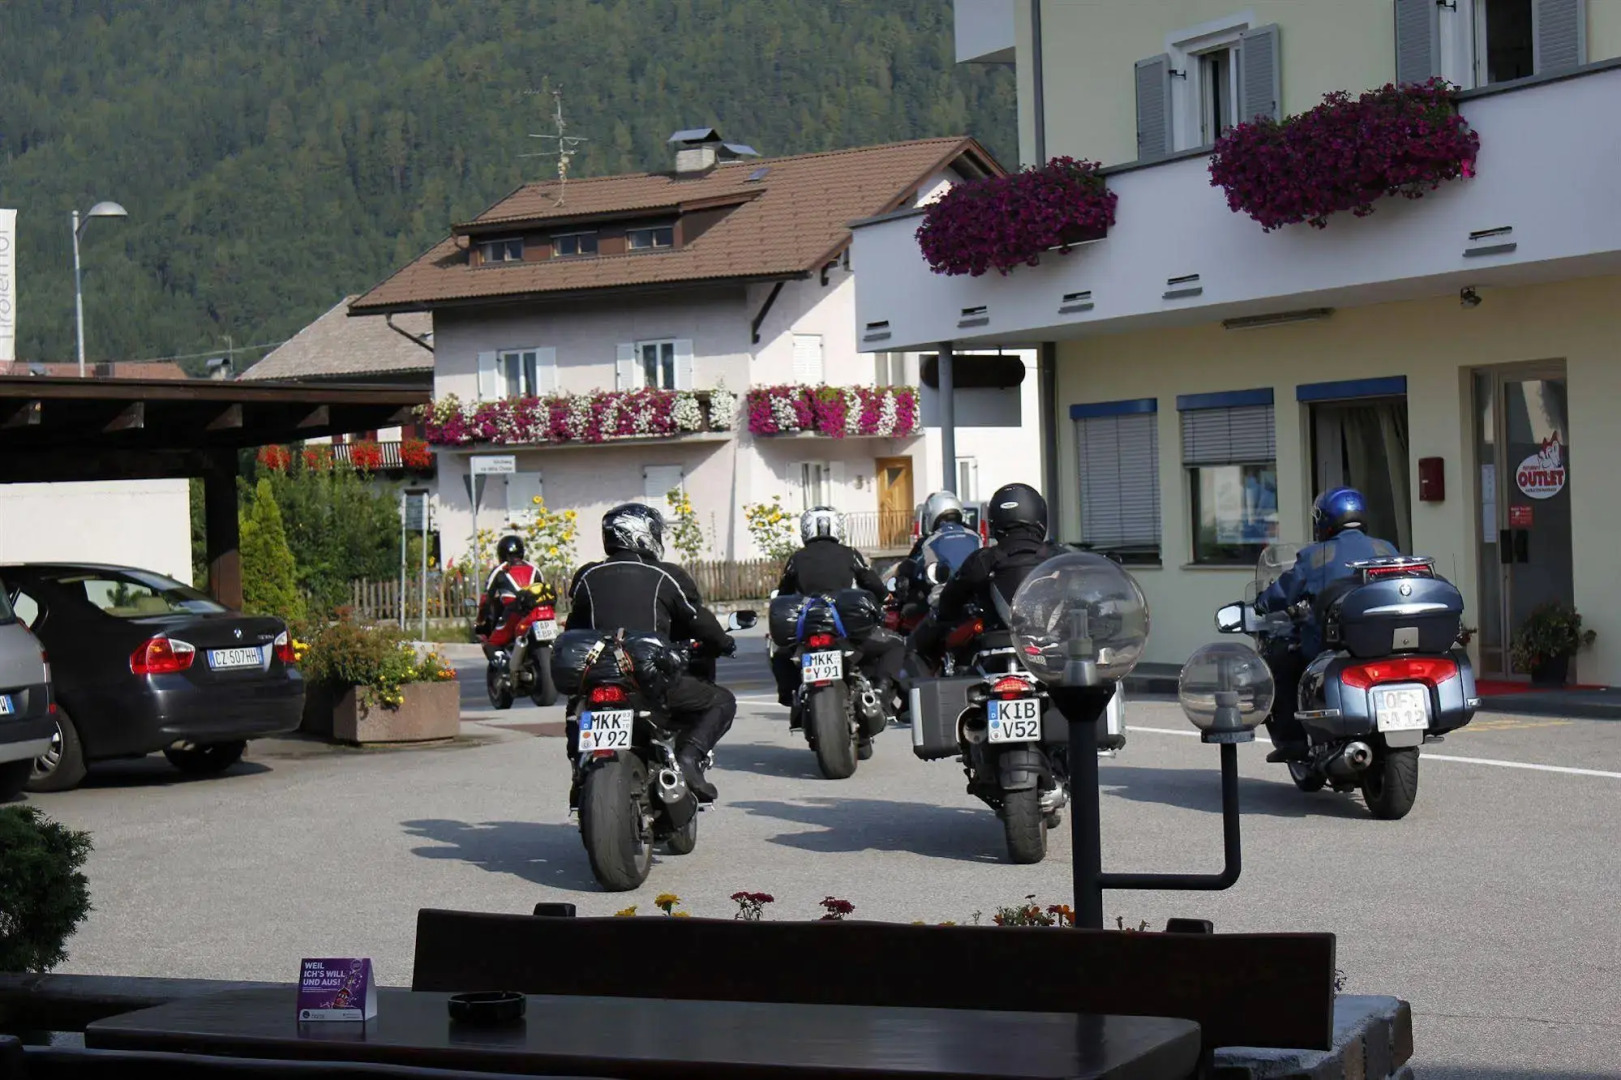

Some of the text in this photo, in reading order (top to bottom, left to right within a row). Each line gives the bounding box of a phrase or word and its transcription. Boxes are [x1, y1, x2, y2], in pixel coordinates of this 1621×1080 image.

[1517, 470, 1564, 487] OUTLET
[215, 649, 258, 665] CZ 507HH
[811, 653, 834, 666] MKK
[824, 665, 839, 678] 91
[999, 702, 1036, 720] KIB
[591, 713, 622, 730] MKK
[1002, 720, 1038, 739] V52
[607, 730, 628, 747] 92
[303, 970, 346, 978] ICH'S WILL
[321, 978, 341, 986] AUS!
